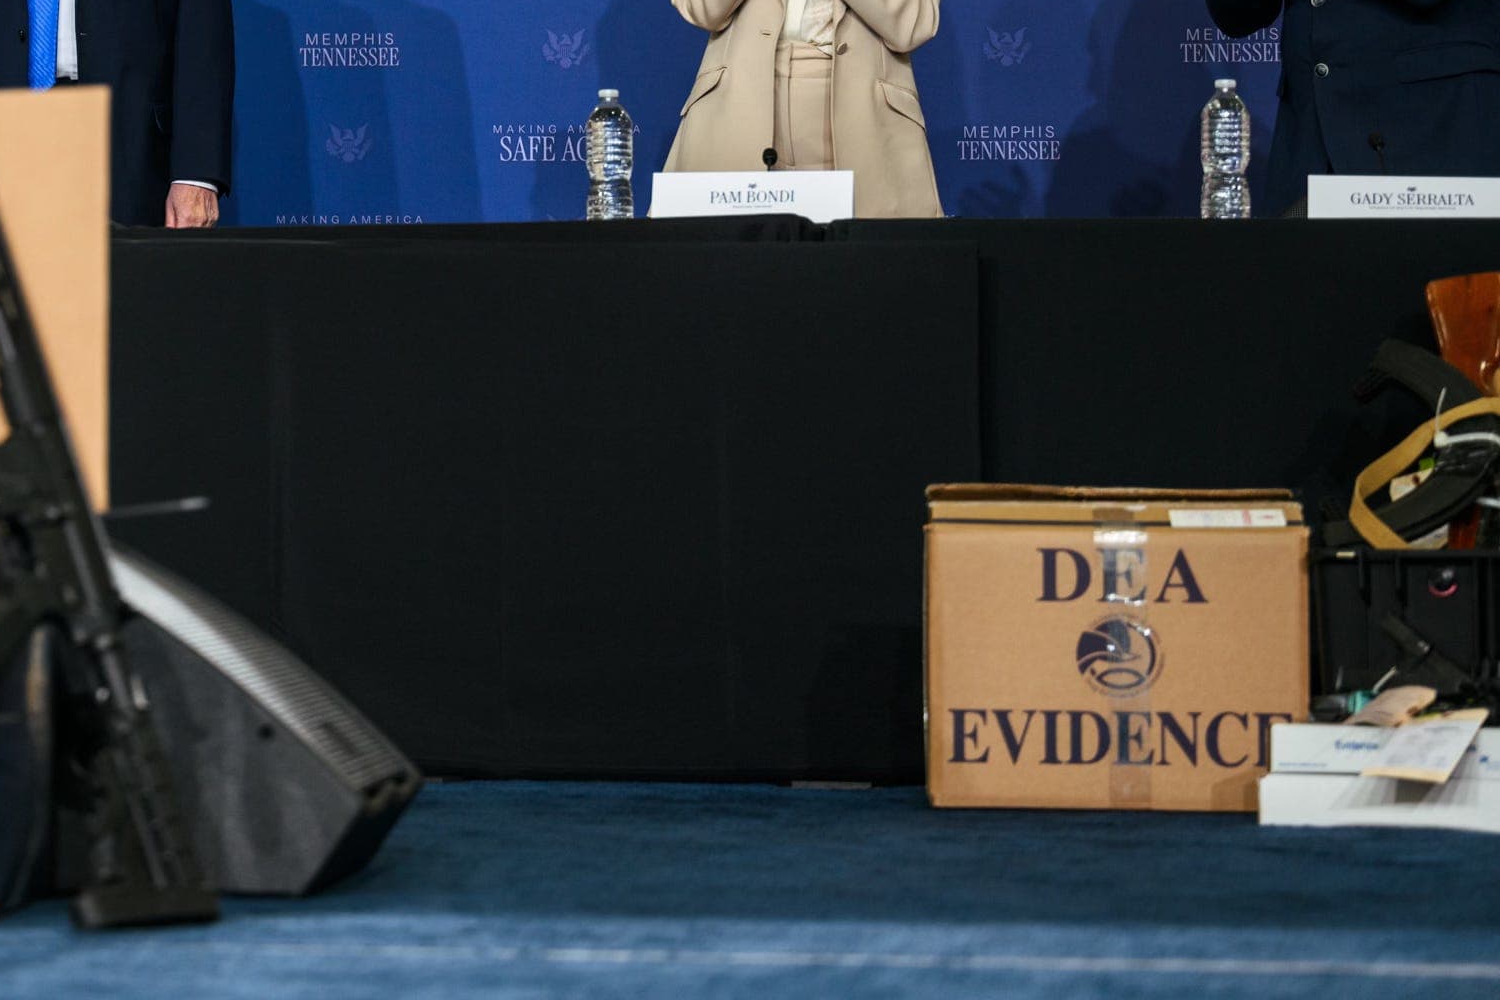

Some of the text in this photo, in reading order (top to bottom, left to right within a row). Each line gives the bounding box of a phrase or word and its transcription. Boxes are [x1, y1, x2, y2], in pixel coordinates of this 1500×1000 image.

[305, 32, 394, 46] MEMPHIS
[299, 46, 400, 67] TENNESSEE
[492, 124, 558, 135] MAKING
[963, 125, 1055, 139] MEMPHIS
[500, 135, 556, 162] SAFE
[957, 140, 1061, 161] TENNESSEE
[710, 190, 795, 204] PAM BONDI
[1350, 192, 1475, 206] GADY SERRALTA
[276, 215, 423, 224] MAKING AMERICA
[1036, 548, 1208, 603] DEA
